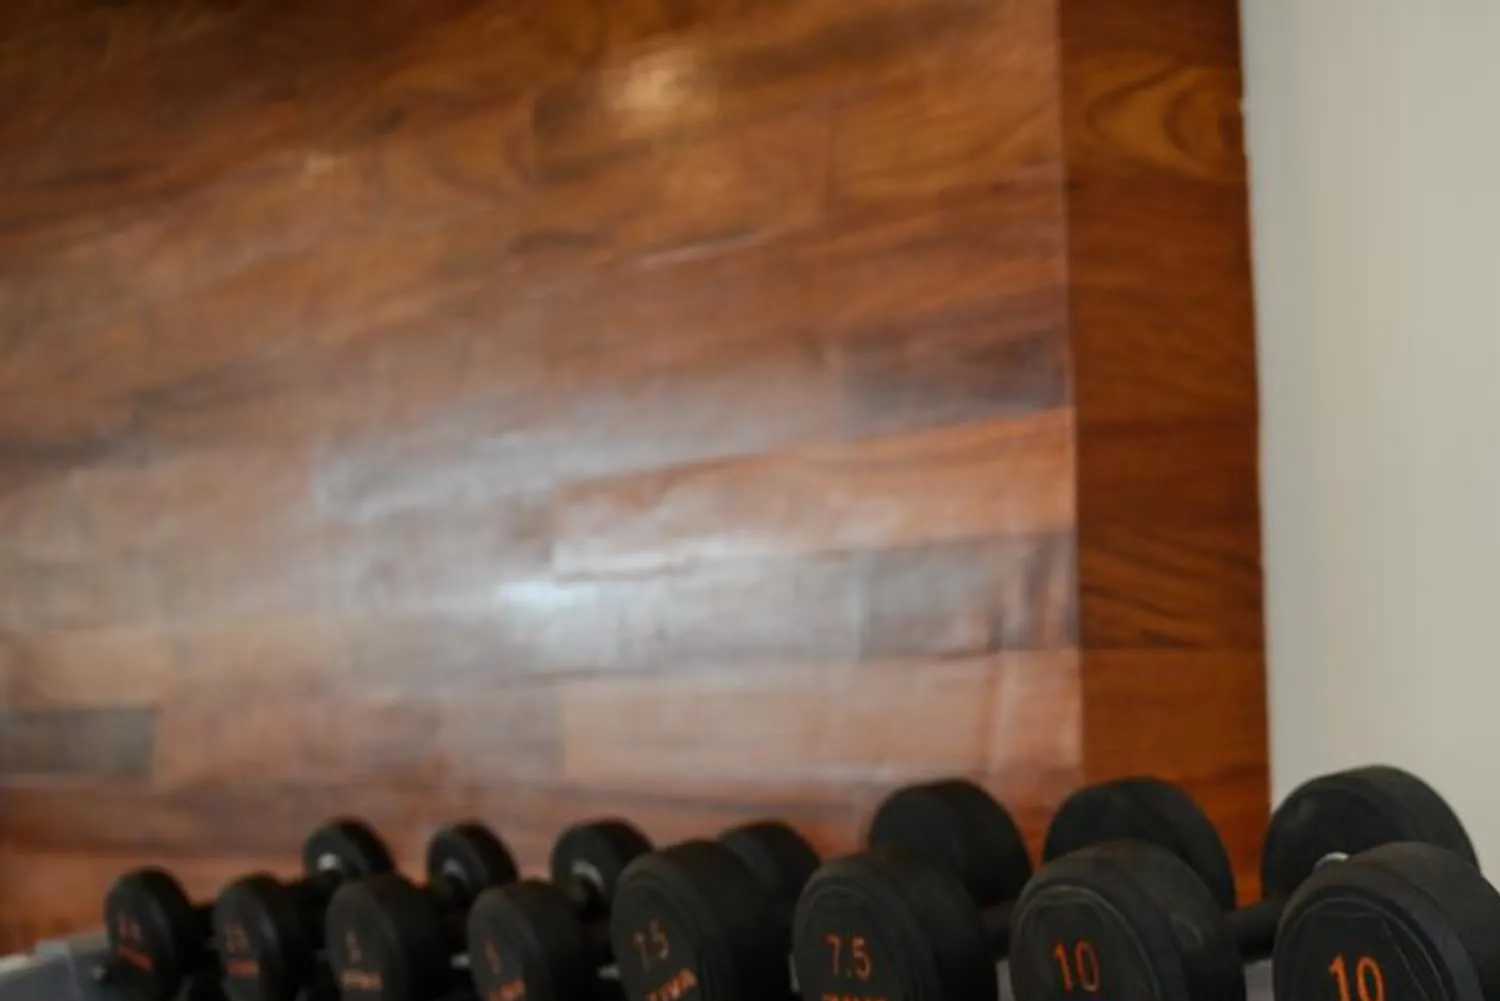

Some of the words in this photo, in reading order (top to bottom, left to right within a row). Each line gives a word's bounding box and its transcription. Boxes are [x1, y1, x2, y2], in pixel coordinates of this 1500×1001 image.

[632, 916, 670, 972] 75
[825, 933, 873, 981] 7.5
[1052, 940, 1099, 992] 10
